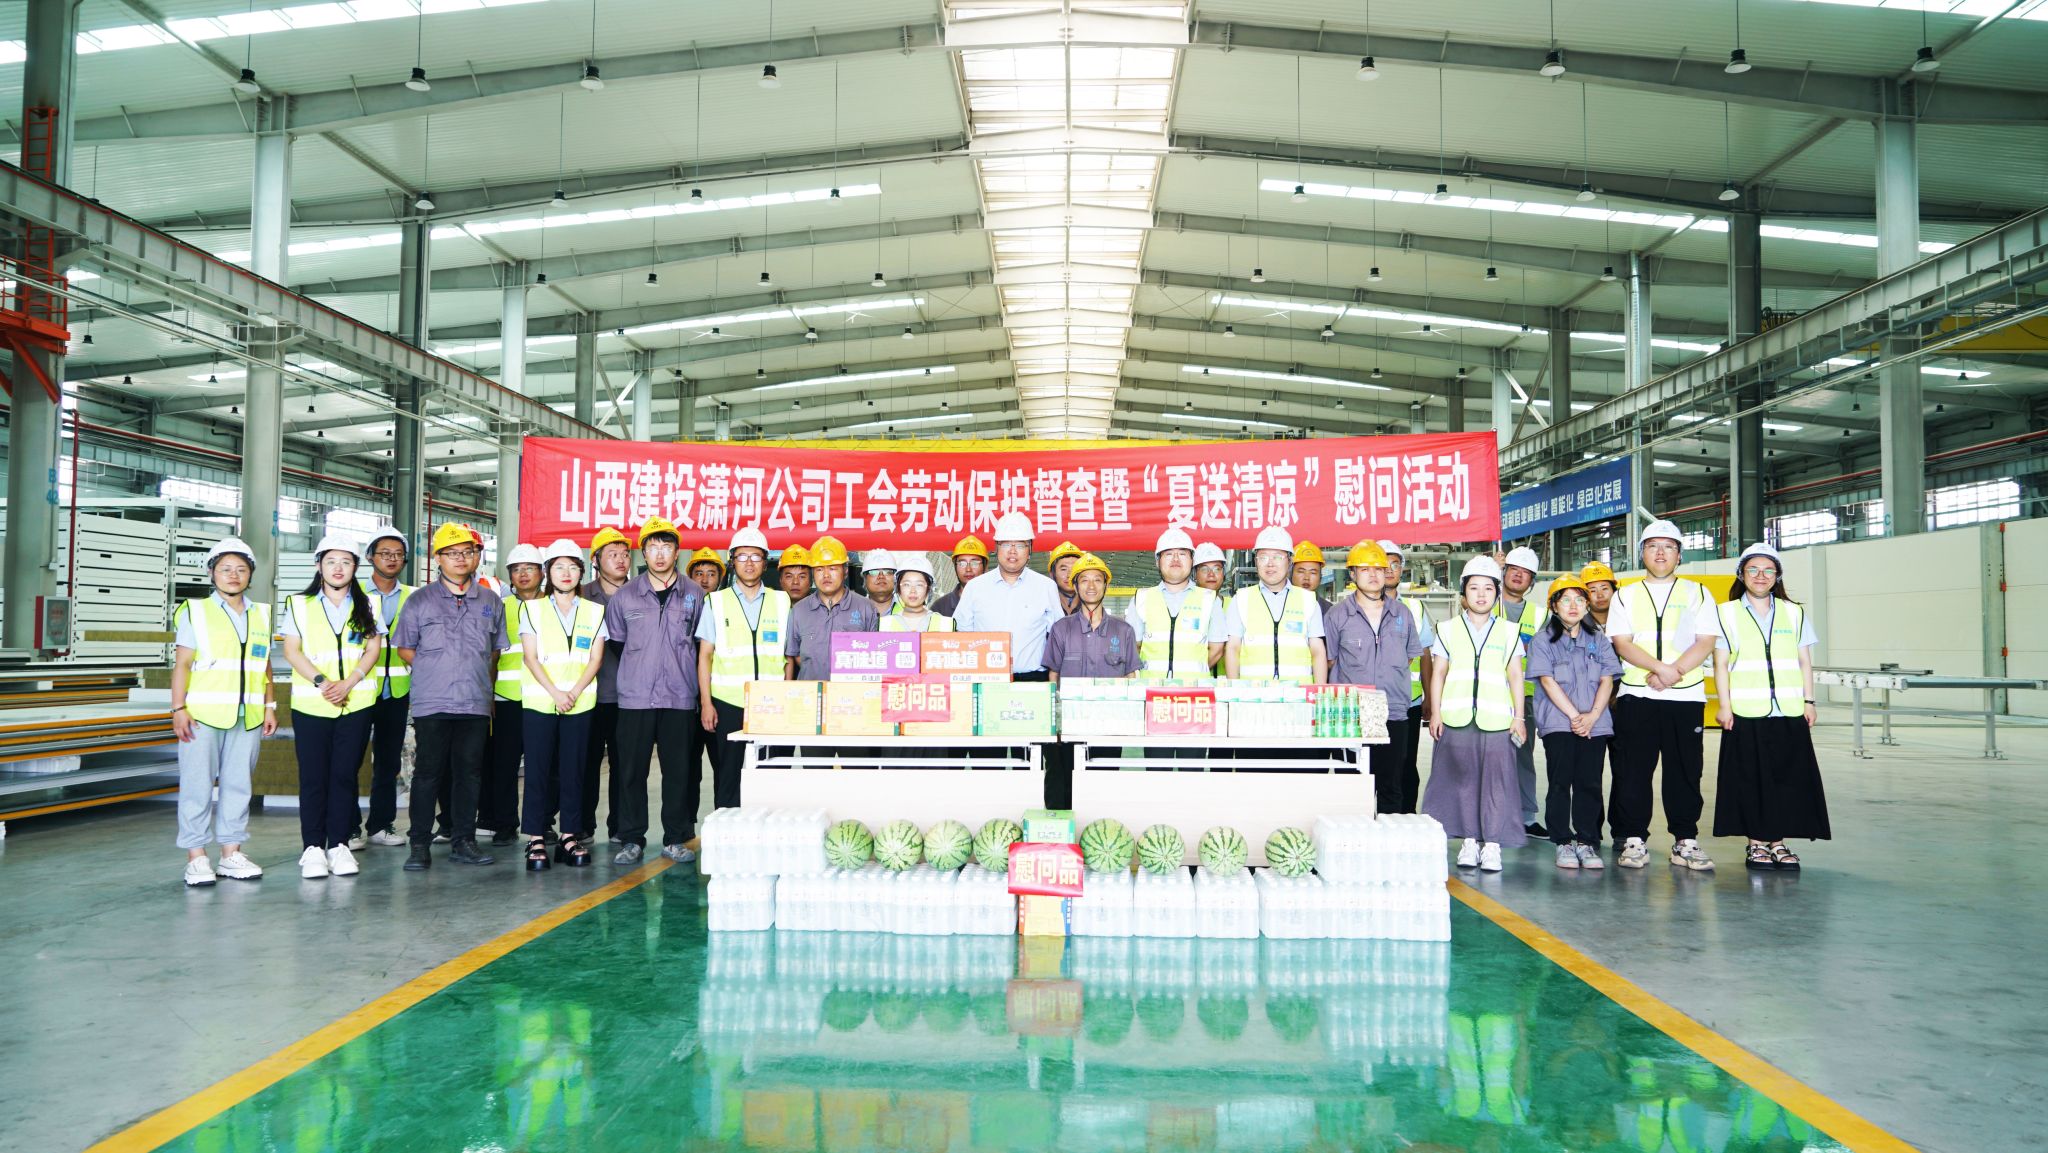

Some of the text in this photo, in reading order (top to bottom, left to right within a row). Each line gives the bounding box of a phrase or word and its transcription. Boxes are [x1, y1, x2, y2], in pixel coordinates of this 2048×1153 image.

[1551, 493, 1574, 517] 智能化
[1577, 478, 1622, 509] 绿色化发展
[887, 683, 948, 712] 慰问品
[1152, 694, 1214, 725] 慰问品
[1015, 853, 1079, 885] 慰问品
